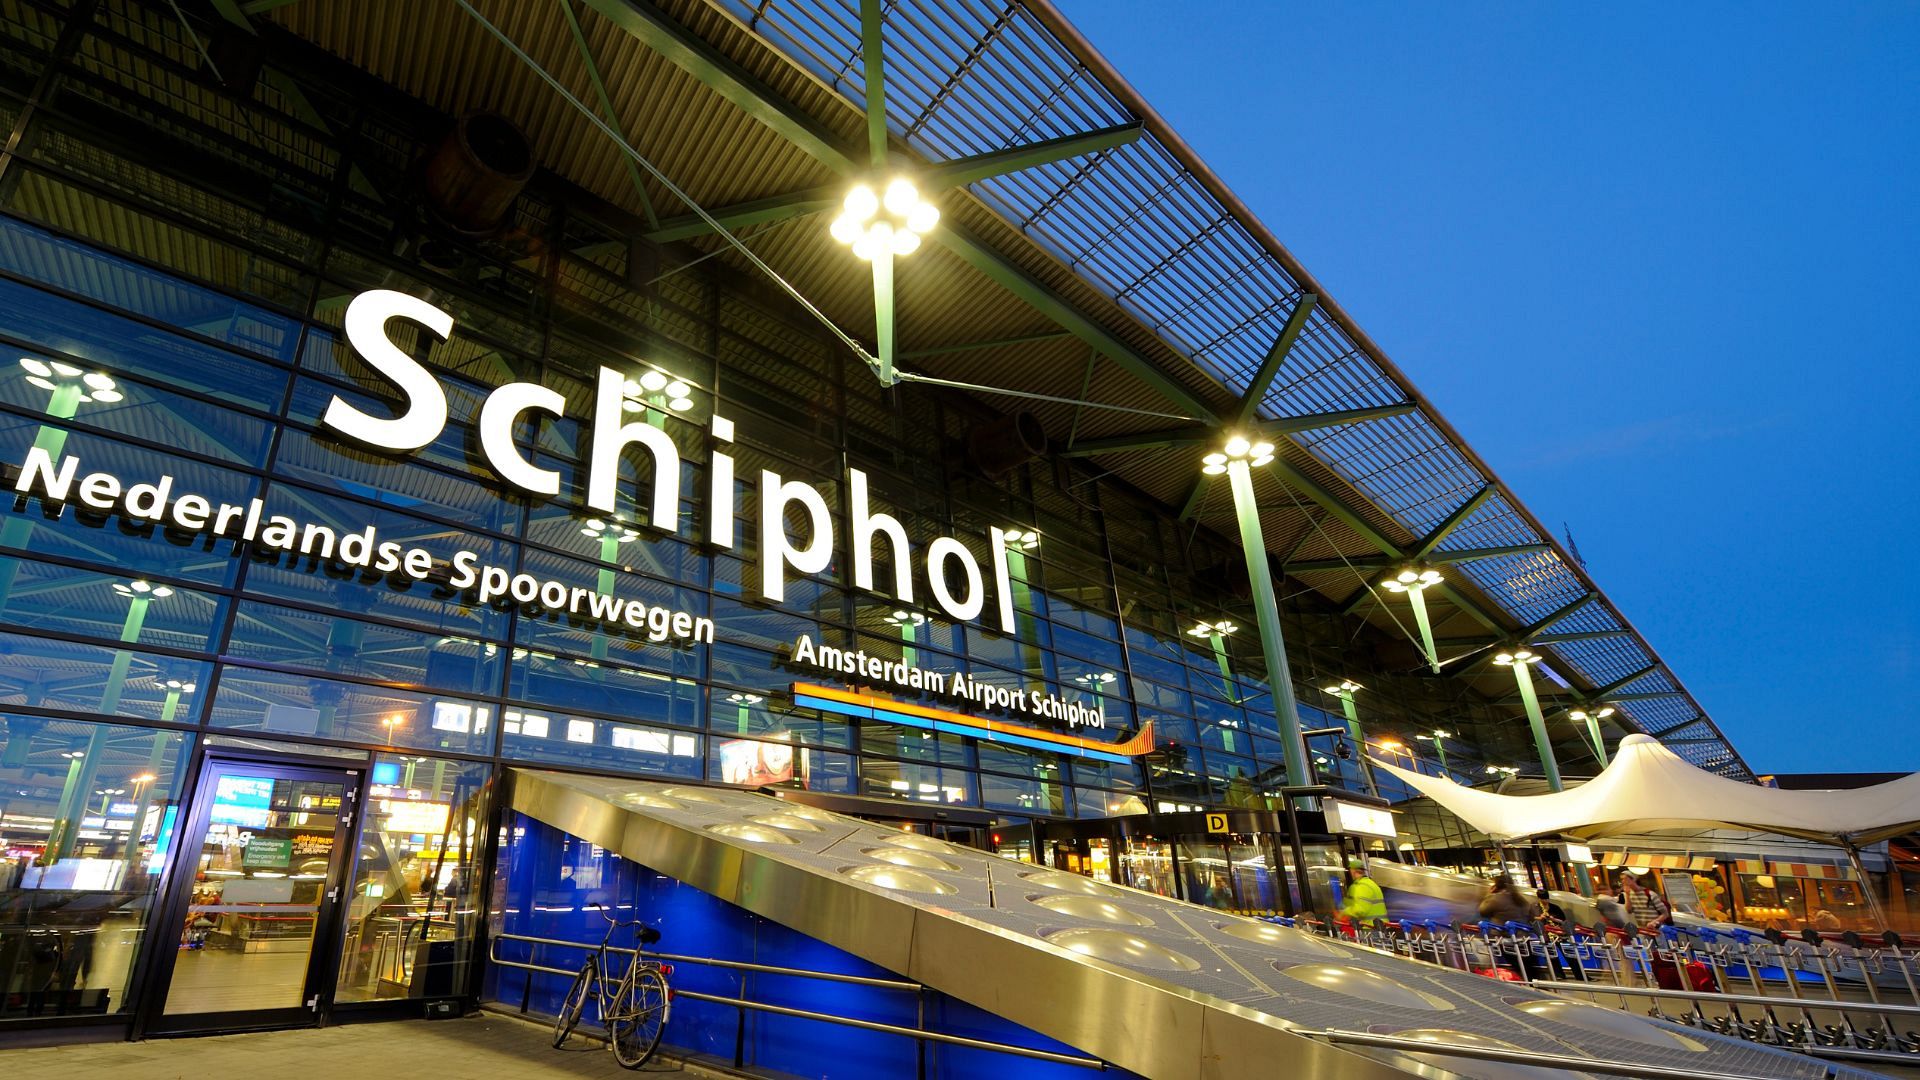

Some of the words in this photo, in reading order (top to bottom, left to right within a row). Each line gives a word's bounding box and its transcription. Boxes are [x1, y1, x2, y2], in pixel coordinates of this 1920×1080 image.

[323, 289, 1017, 634] Schiphol
[15, 446, 434, 580] Nederlandse
[449, 550, 716, 645] Spoorwegen
[796, 634, 944, 694] Amsterdam
[951, 671, 1026, 711] Airport
[1031, 690, 1106, 730] Schiphol
[1211, 815, 1224, 831] D
